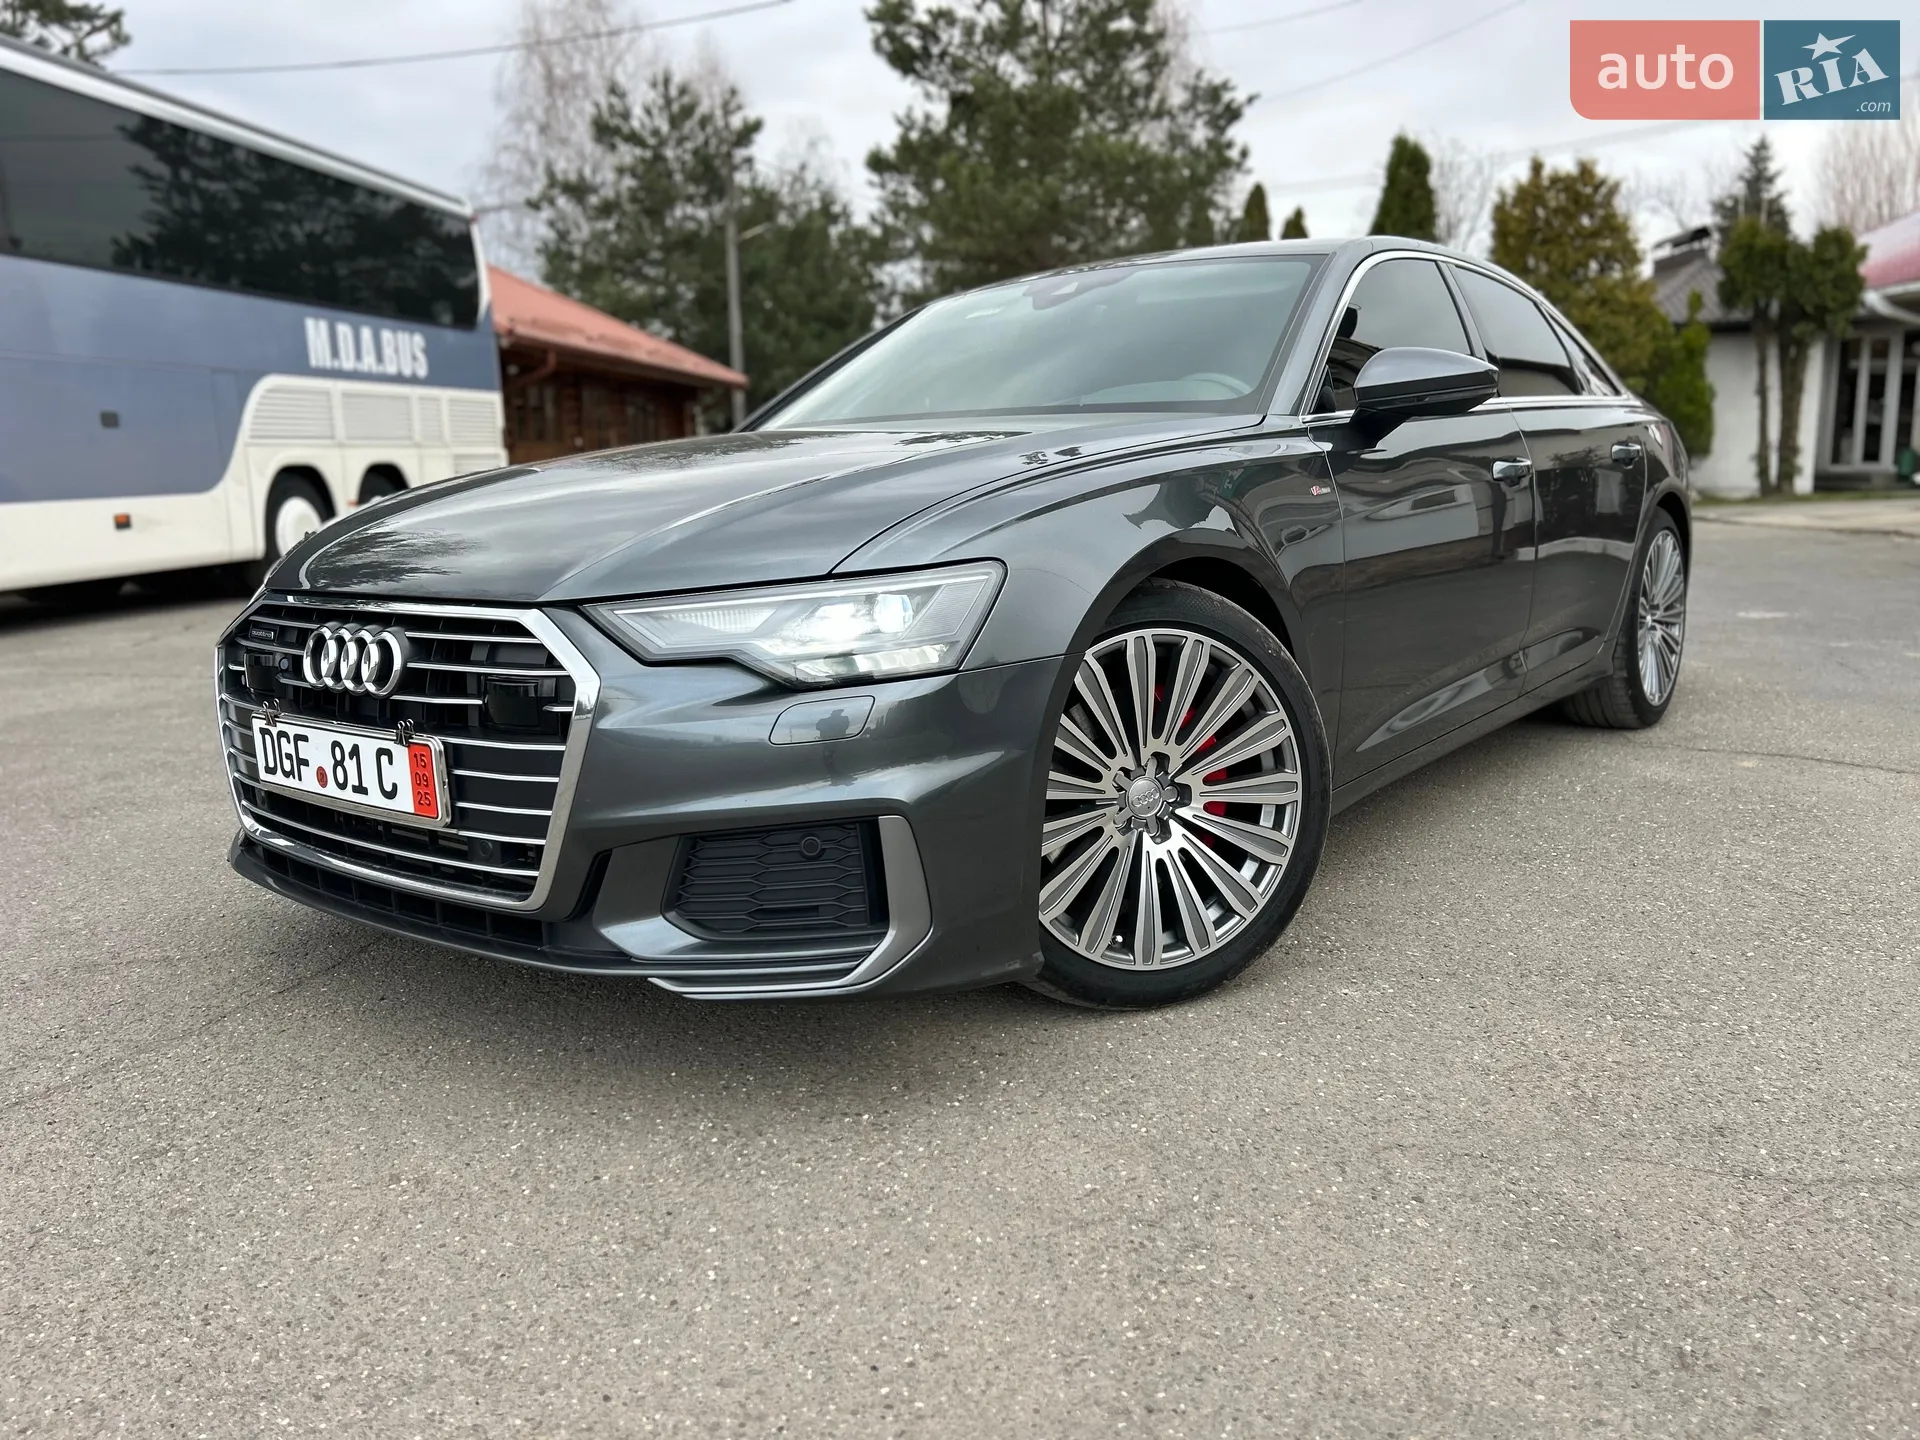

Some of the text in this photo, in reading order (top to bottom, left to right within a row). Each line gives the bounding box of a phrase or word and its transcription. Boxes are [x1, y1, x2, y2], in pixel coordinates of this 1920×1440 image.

[304, 316, 429, 380] M.D.A.BUS
[259, 727, 310, 781] DGF
[331, 740, 369, 795] 81
[375, 747, 398, 800] C
[413, 752, 427, 768] 15
[415, 771, 429, 788] 09
[417, 790, 431, 807] 25
